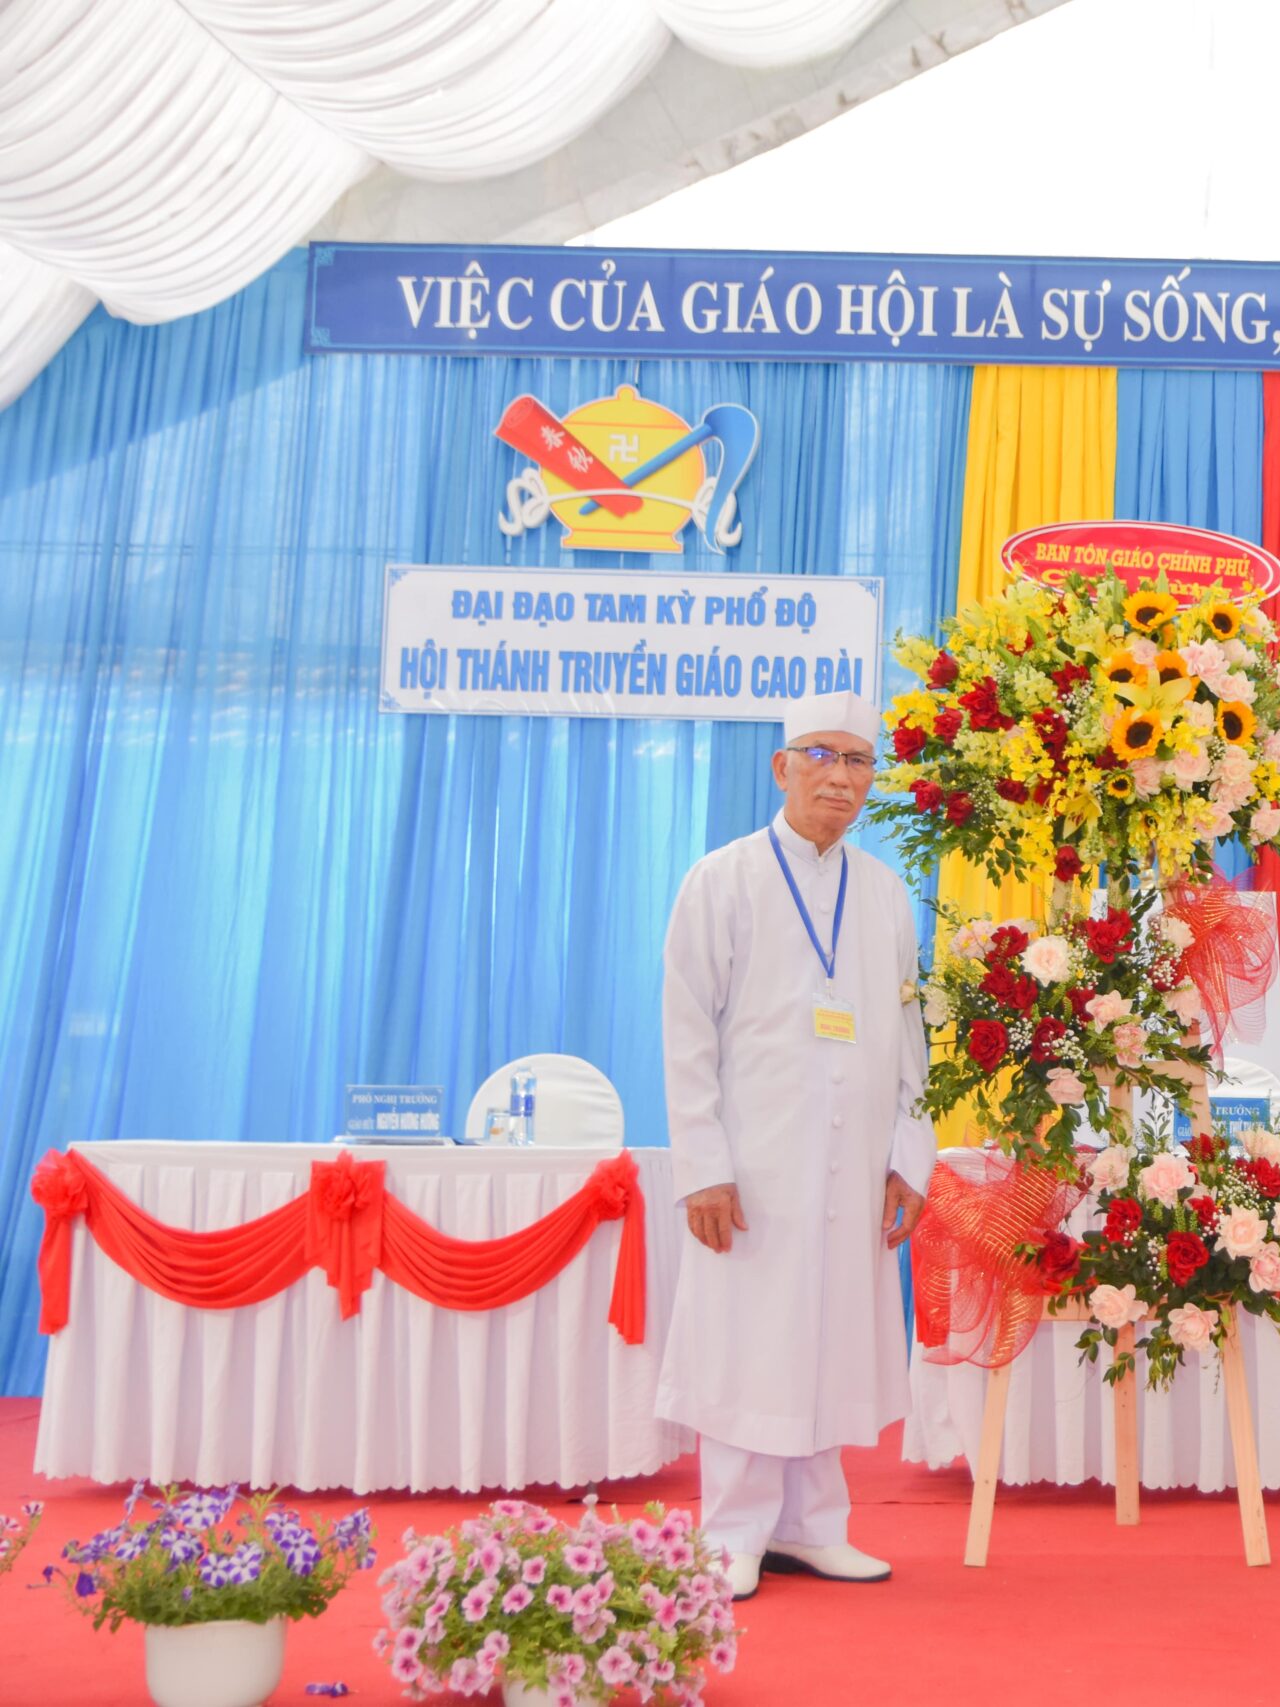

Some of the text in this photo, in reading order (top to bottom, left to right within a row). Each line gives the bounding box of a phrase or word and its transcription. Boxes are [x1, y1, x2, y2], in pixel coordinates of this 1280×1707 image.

[397, 260, 534, 340] VIỆC
[549, 259, 665, 332] CỦA
[681, 266, 822, 335] GIÁO
[835, 269, 939, 347] HỘI
[951, 271, 1024, 339] LÀ
[1041, 279, 1112, 352] SỰ
[1036, 543, 1251, 577] BAN TÔN GIÁO CHÍNH PHỦ
[451, 586, 817, 634] ĐẠI ĐẠO TAM KỲ PHỔ ĐỘ
[400, 638, 863, 699] HỘI THÁNH TRUYỀN GIÁO CAO ĐÀI
